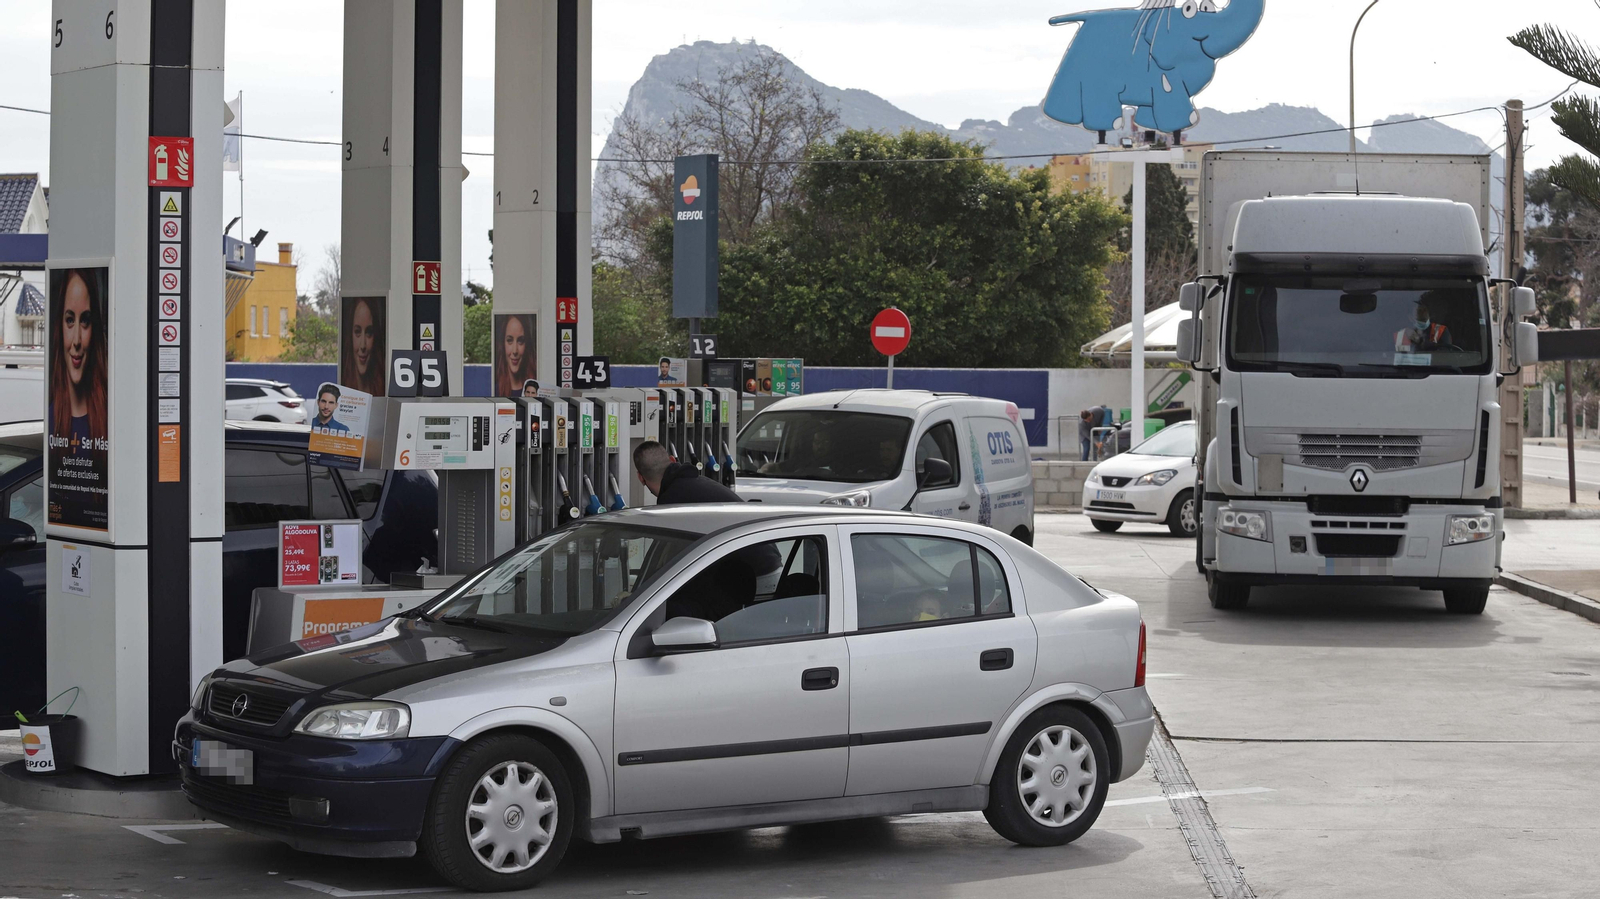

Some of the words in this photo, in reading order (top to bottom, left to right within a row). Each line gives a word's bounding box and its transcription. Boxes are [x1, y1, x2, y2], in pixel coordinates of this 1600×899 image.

[55, 18, 63, 48] 5
[106, 10, 114, 40] 6
[346, 141, 352, 161] 3
[383, 136, 389, 156] 4
[496, 191, 501, 206] 1
[532, 189, 539, 204] 2
[677, 210, 704, 221] REPSOL
[693, 339, 703, 354] 1
[704, 338, 715, 354] 2
[394, 358, 415, 388] 6
[421, 358, 441, 388] 5
[577, 362, 592, 383] 4
[594, 361, 606, 382] 3
[776, 382, 785, 390] 95
[791, 382, 800, 390] 95
[584, 417, 590, 426] 95
[610, 417, 615, 426] 98
[49, 435, 68, 449] Quiero
[82, 437, 93, 450] Ser
[95, 436, 108, 451] Más
[987, 430, 1013, 456] OTIS
[62, 456, 75, 467] Quiero
[76, 457, 93, 467] disfrutar
[400, 450, 410, 466] 6
[57, 468, 62, 477] de
[63, 469, 77, 478] ofertas
[78, 470, 99, 480] exclusivas
[304, 621, 369, 635] Program
